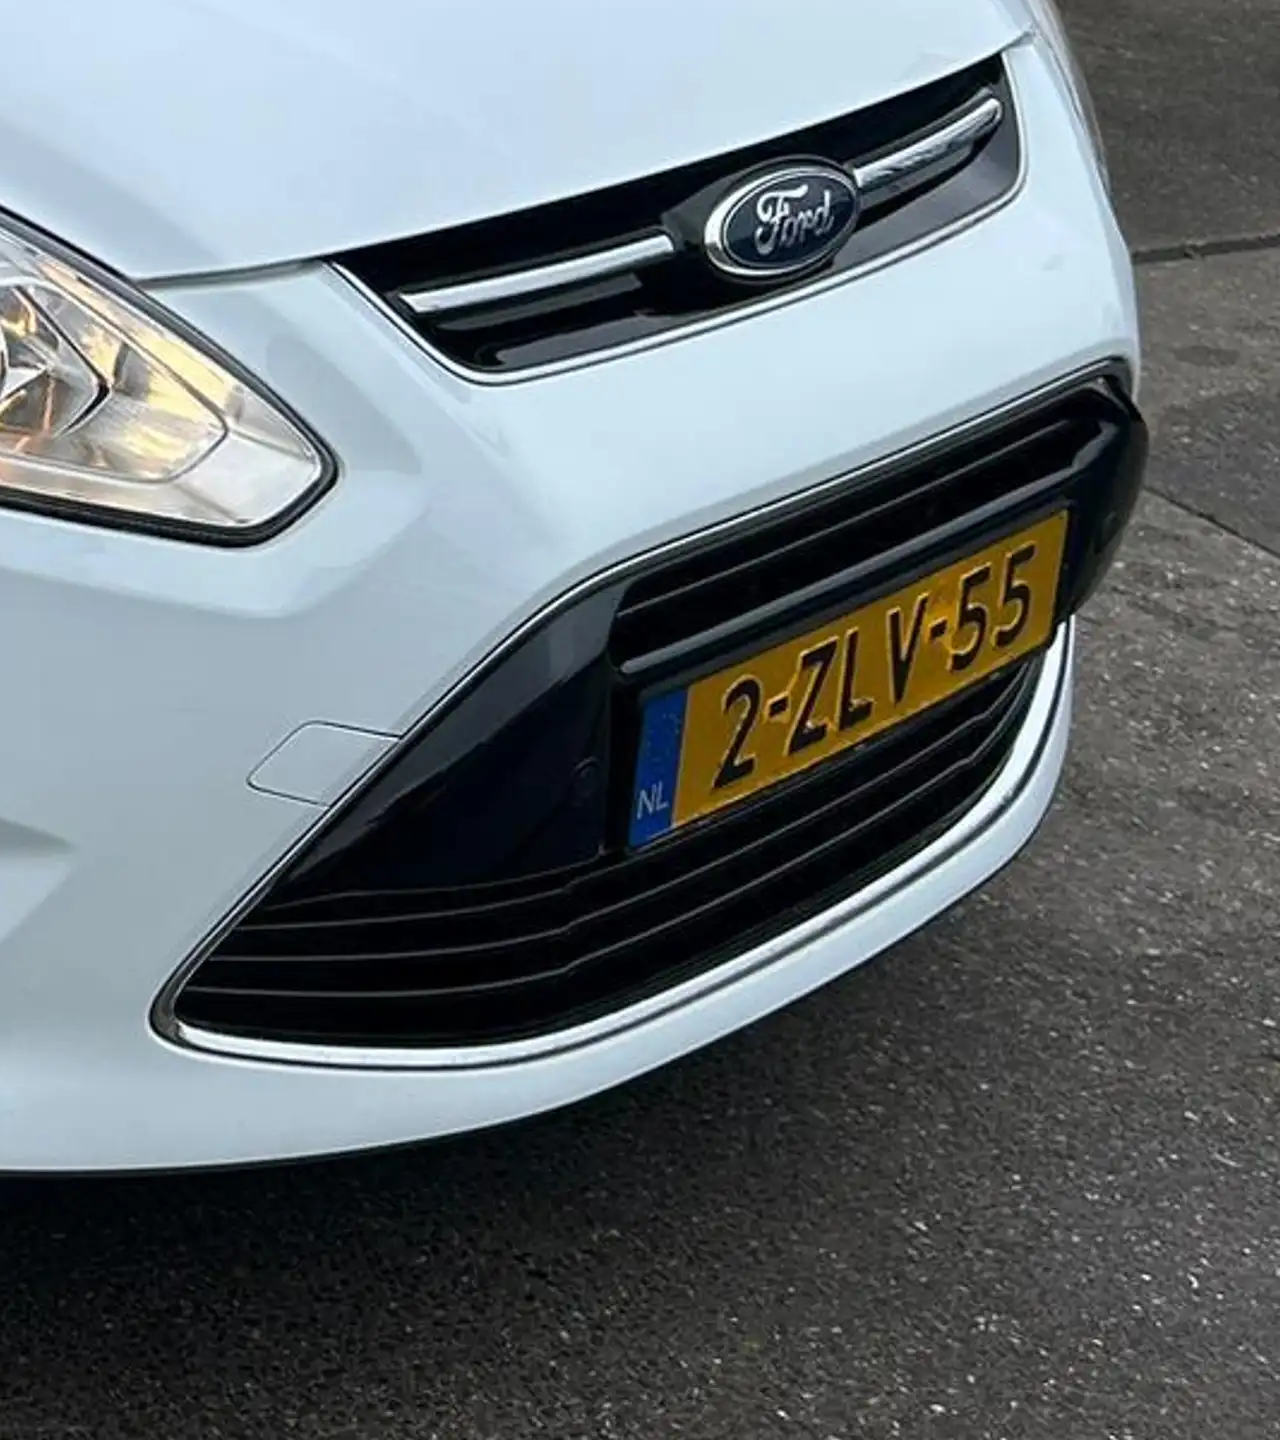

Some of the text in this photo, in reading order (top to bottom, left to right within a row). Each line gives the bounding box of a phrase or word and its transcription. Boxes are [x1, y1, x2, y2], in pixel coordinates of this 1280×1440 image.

[755, 184, 834, 255] Ford
[712, 540, 1037, 790] 2-ZLV-55
[637, 780, 669, 820] NL
